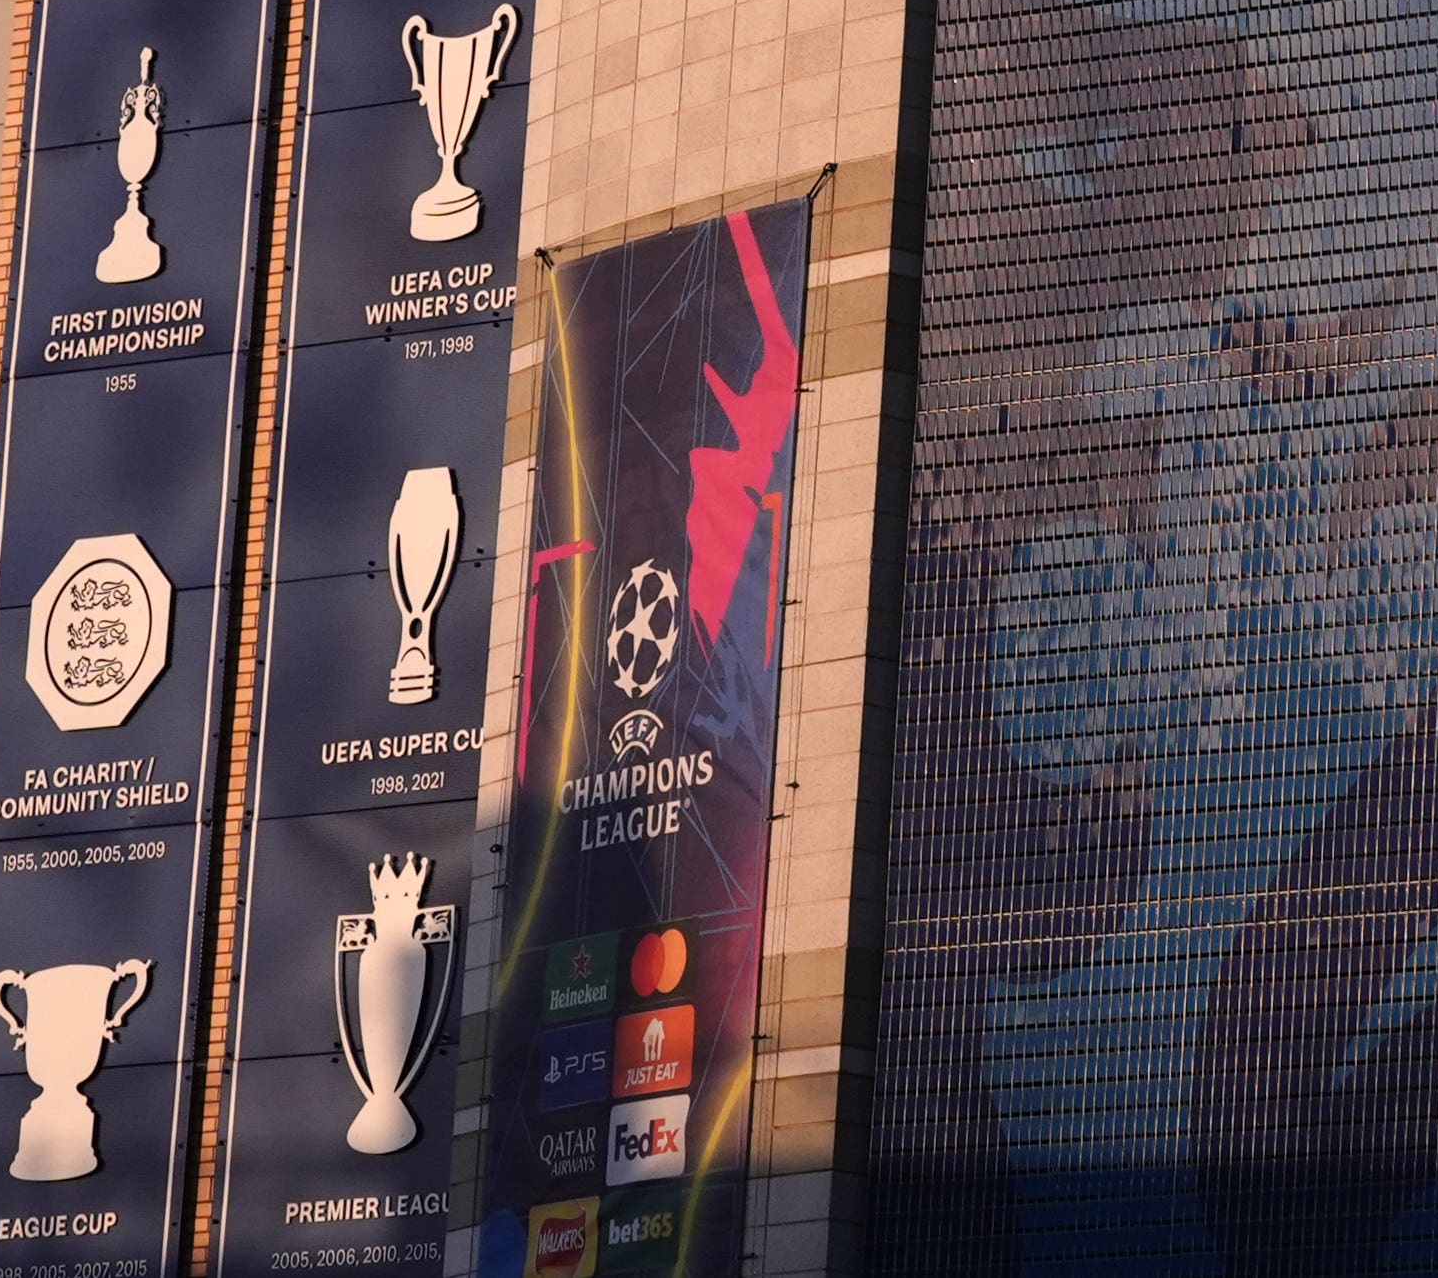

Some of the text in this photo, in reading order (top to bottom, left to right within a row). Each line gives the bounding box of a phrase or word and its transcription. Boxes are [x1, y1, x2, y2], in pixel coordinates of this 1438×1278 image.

[389, 262, 494, 297] UEFA CUP
[50, 298, 204, 335] FIRST DIVISION
[365, 285, 517, 325] WINNER'S CUP
[43, 323, 205, 363] CHAMPIONSHIP
[403, 334, 475, 360] 1971, 1998
[104, 373, 137, 393] 1955
[321, 739, 373, 765] UEFA
[378, 733, 447, 761] SUPER
[611, 716, 661, 753] UEFA
[24, 769, 48, 791] FA
[53, 759, 142, 788] CHARITY
[370, 771, 444, 796] 1998, 2021
[560, 750, 714, 814] CHAMPIONS
[116, 781, 190, 808] SHIELD
[2, 842, 166, 873] 1955, 2000, 2005, 2009
[549, 982, 608, 1011] Heineken
[565, 1051, 607, 1076] PS5
[625, 1061, 679, 1088] JUST EAT
[540, 1127, 596, 1165] QATAR
[613, 1118, 680, 1163] FedEx
[72, 1212, 117, 1235] CUP
[285, 1197, 380, 1224] PREMIER
[538, 1227, 585, 1255] WALKERS
[608, 1212, 673, 1245] bet365
[115, 1260, 148, 1277] 2015
[271, 1242, 442, 1270] 2005, 2006, 2010, 2015,
